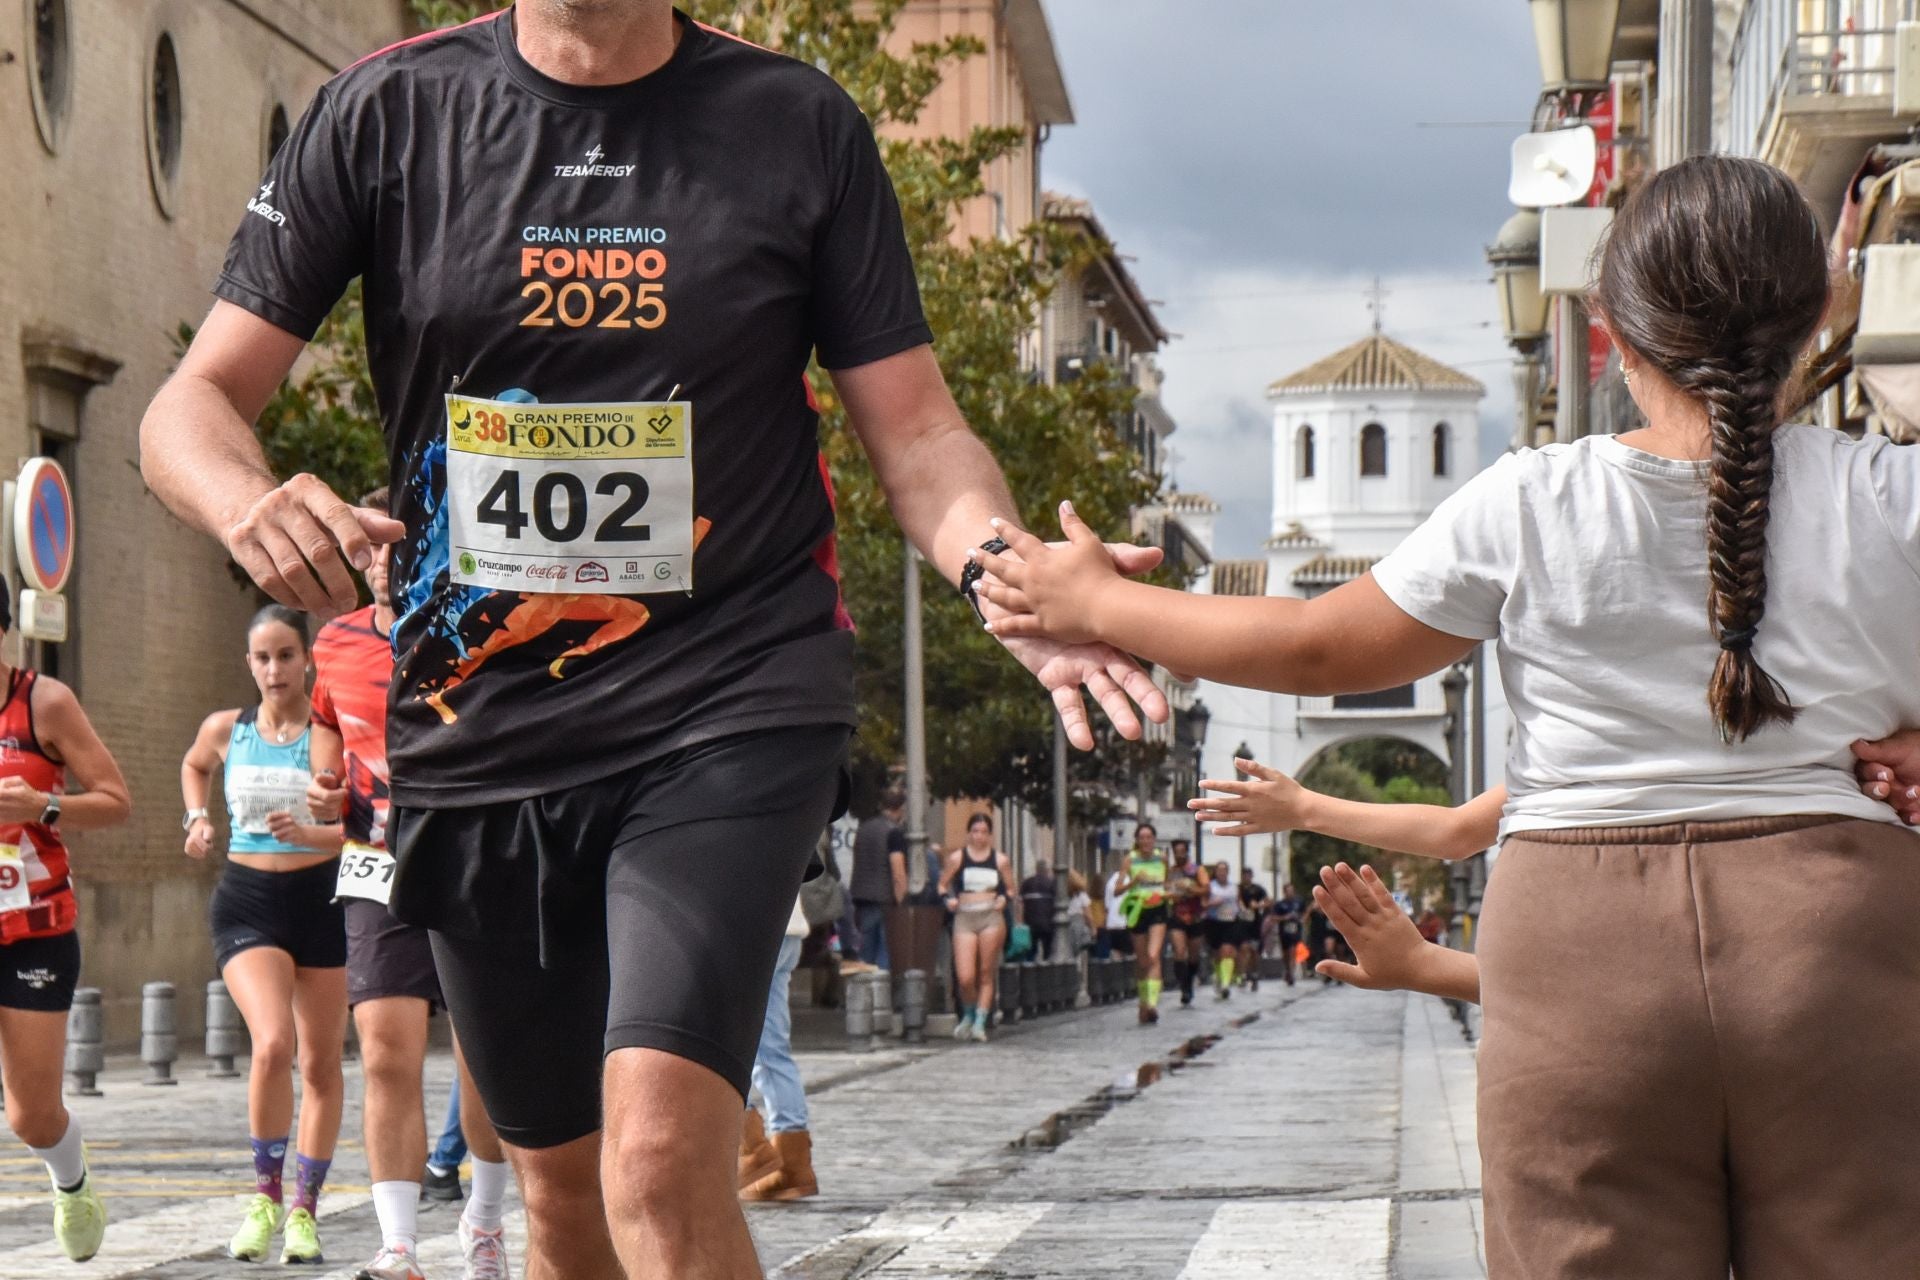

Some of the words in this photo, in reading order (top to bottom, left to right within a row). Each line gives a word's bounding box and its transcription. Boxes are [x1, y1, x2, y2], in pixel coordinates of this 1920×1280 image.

[554, 164, 636, 178] TEAMERGY
[522, 226, 579, 243] GRAN
[586, 227, 667, 244] PREMIO
[521, 247, 667, 279] FONDO
[519, 281, 668, 329] 2025
[474, 410, 507, 443] 38
[514, 413, 557, 424] GRAN
[563, 413, 622, 424] PREMIO
[625, 414, 634, 423] DE
[507, 423, 636, 449] FONDO
[476, 469, 651, 543] 402
[478, 558, 522, 573] Cruzcampo
[340, 855, 396, 883] 651
